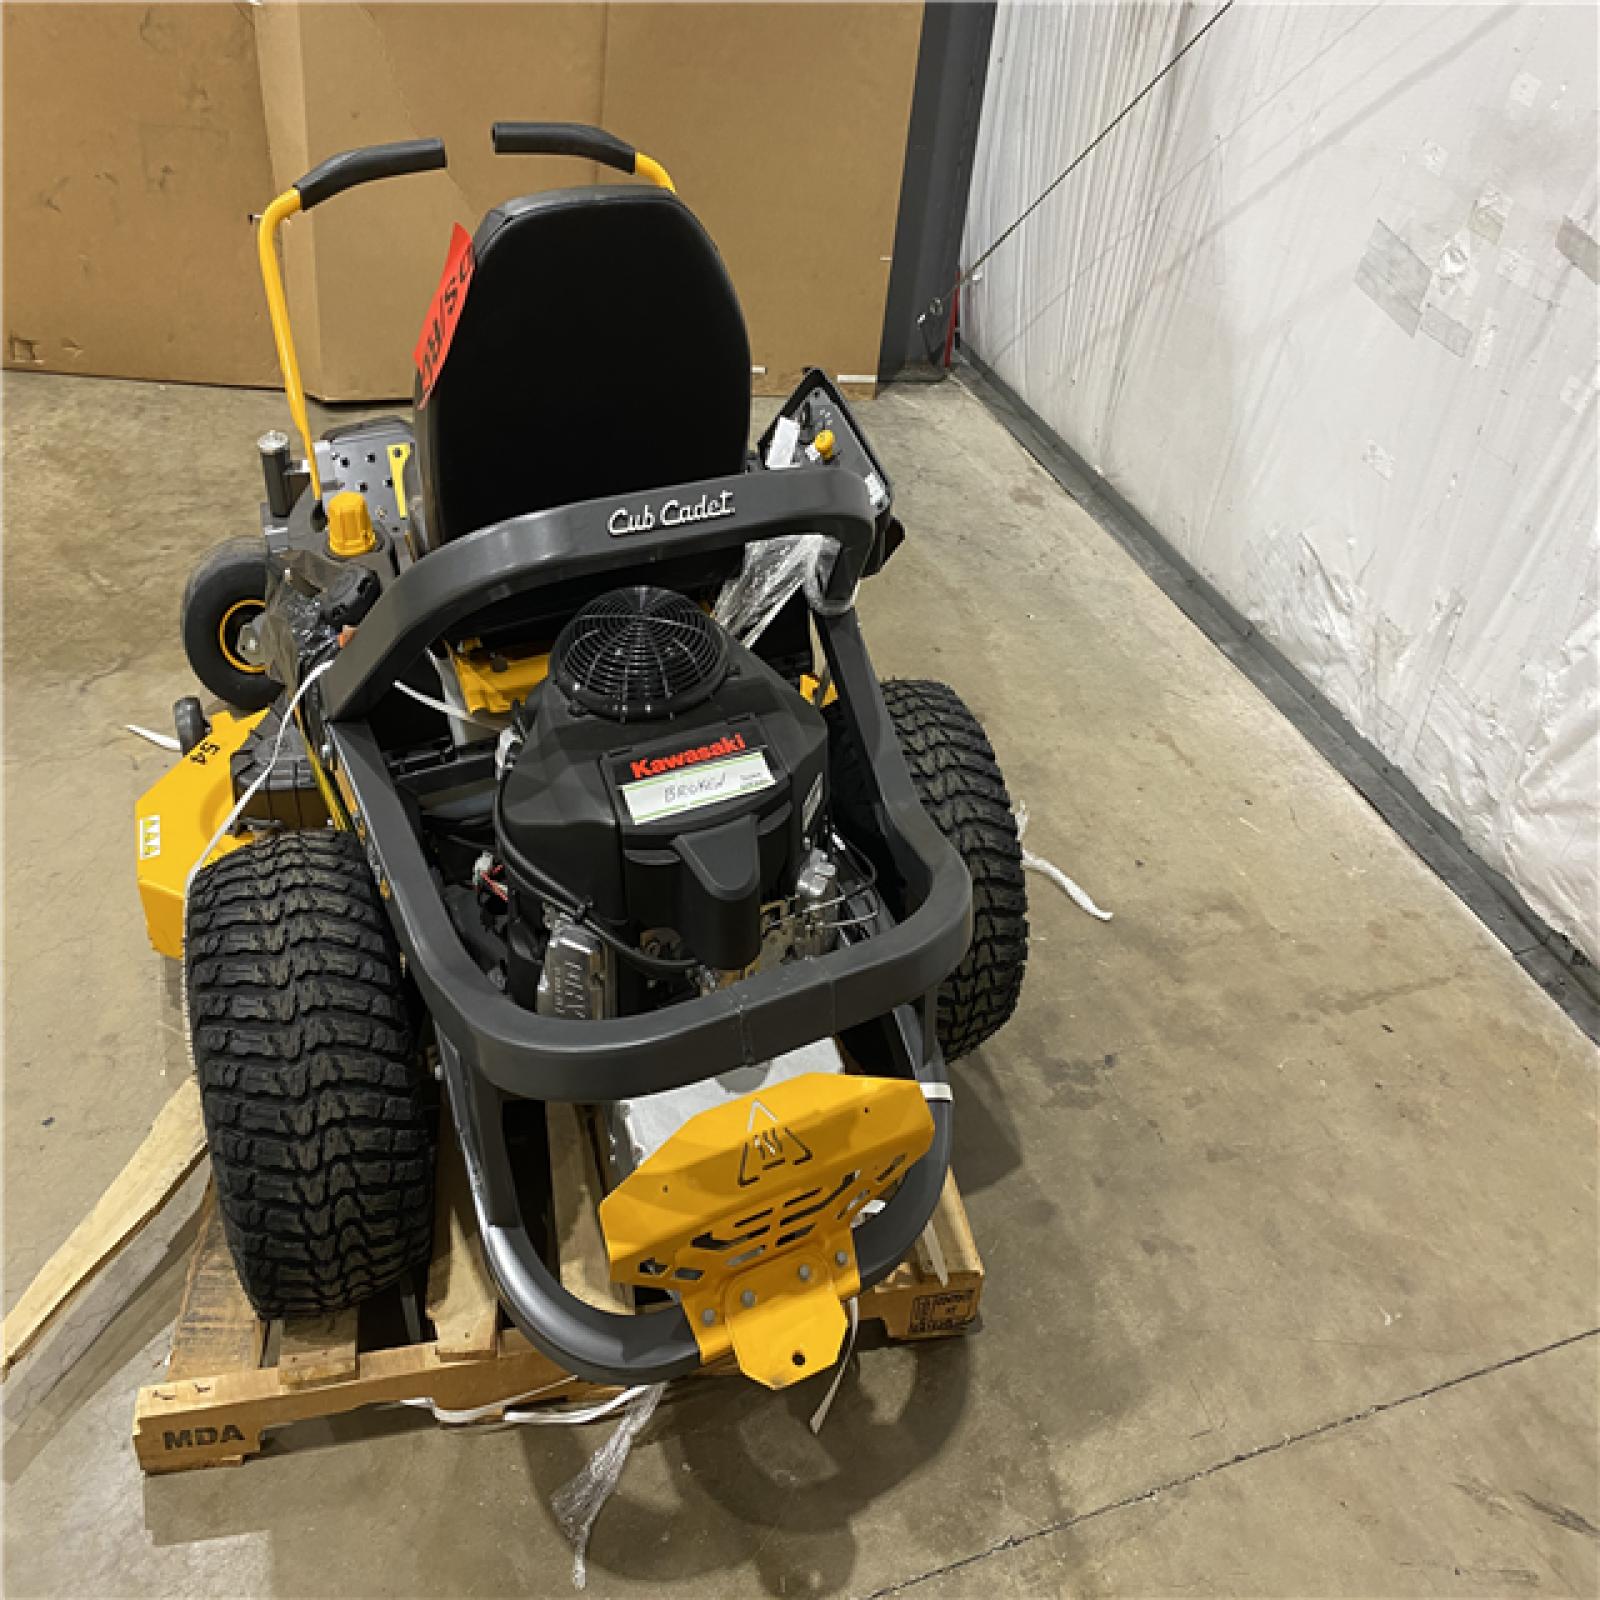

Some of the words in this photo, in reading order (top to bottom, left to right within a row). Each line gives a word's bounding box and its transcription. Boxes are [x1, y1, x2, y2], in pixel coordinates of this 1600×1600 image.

[608, 505, 656, 535] Cub
[660, 489, 736, 526] Cadet
[190, 742, 220, 765] 54
[630, 733, 746, 779] Kawasaki
[163, 1424, 246, 1450] MDA
